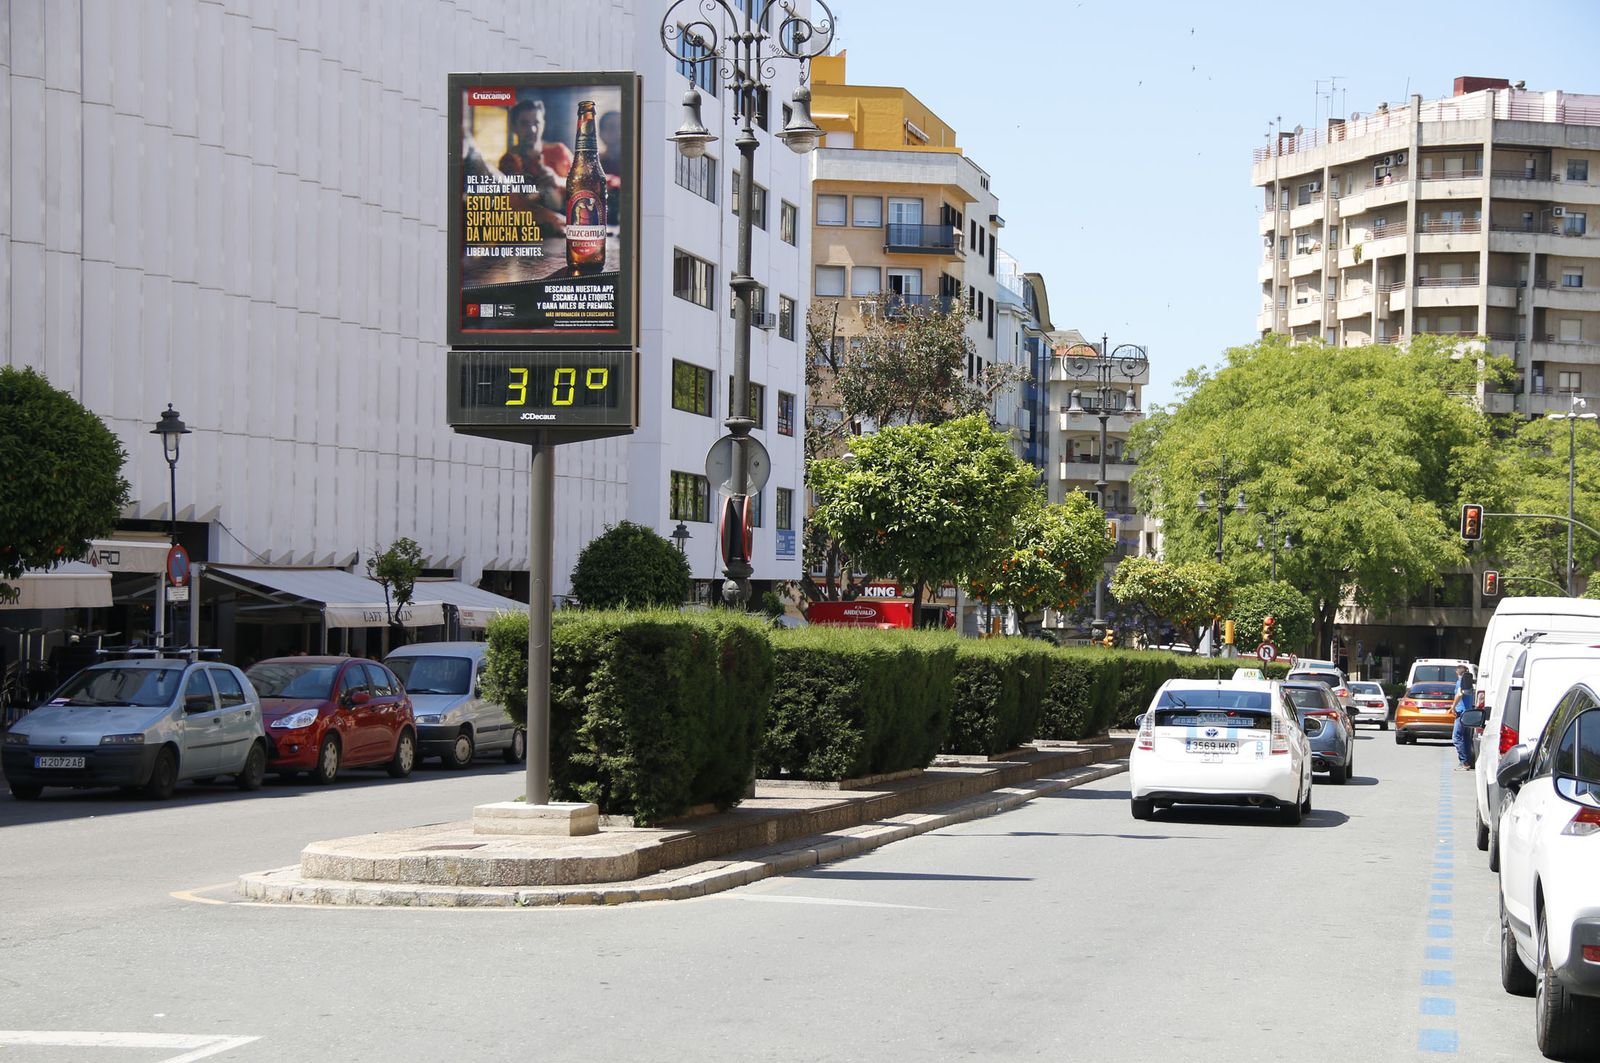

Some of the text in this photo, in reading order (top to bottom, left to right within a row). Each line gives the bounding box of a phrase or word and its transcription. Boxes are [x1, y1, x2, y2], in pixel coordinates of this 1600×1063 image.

[473, 92, 511, 100] Cruzcampo
[467, 175, 525, 184] DEL 12-1 A MALTA
[467, 185, 539, 193] AL INIESTA DE MI VIDA.
[466, 196, 512, 211] ESTO DEL
[466, 211, 536, 226] SUFRIMIENTO,
[466, 226, 544, 241] DA MUCHA SED.
[566, 227, 606, 238] Cruzcampo
[466, 247, 544, 258] LIBERA LO QUE SIENTES.
[544, 285, 574, 293] DESCARGA
[576, 285, 601, 293] NUESTRA
[588, 294, 614, 302] ETIQUETA
[864, 586, 896, 598] KING
[1193, 742, 1237, 751] 3569 HKR
